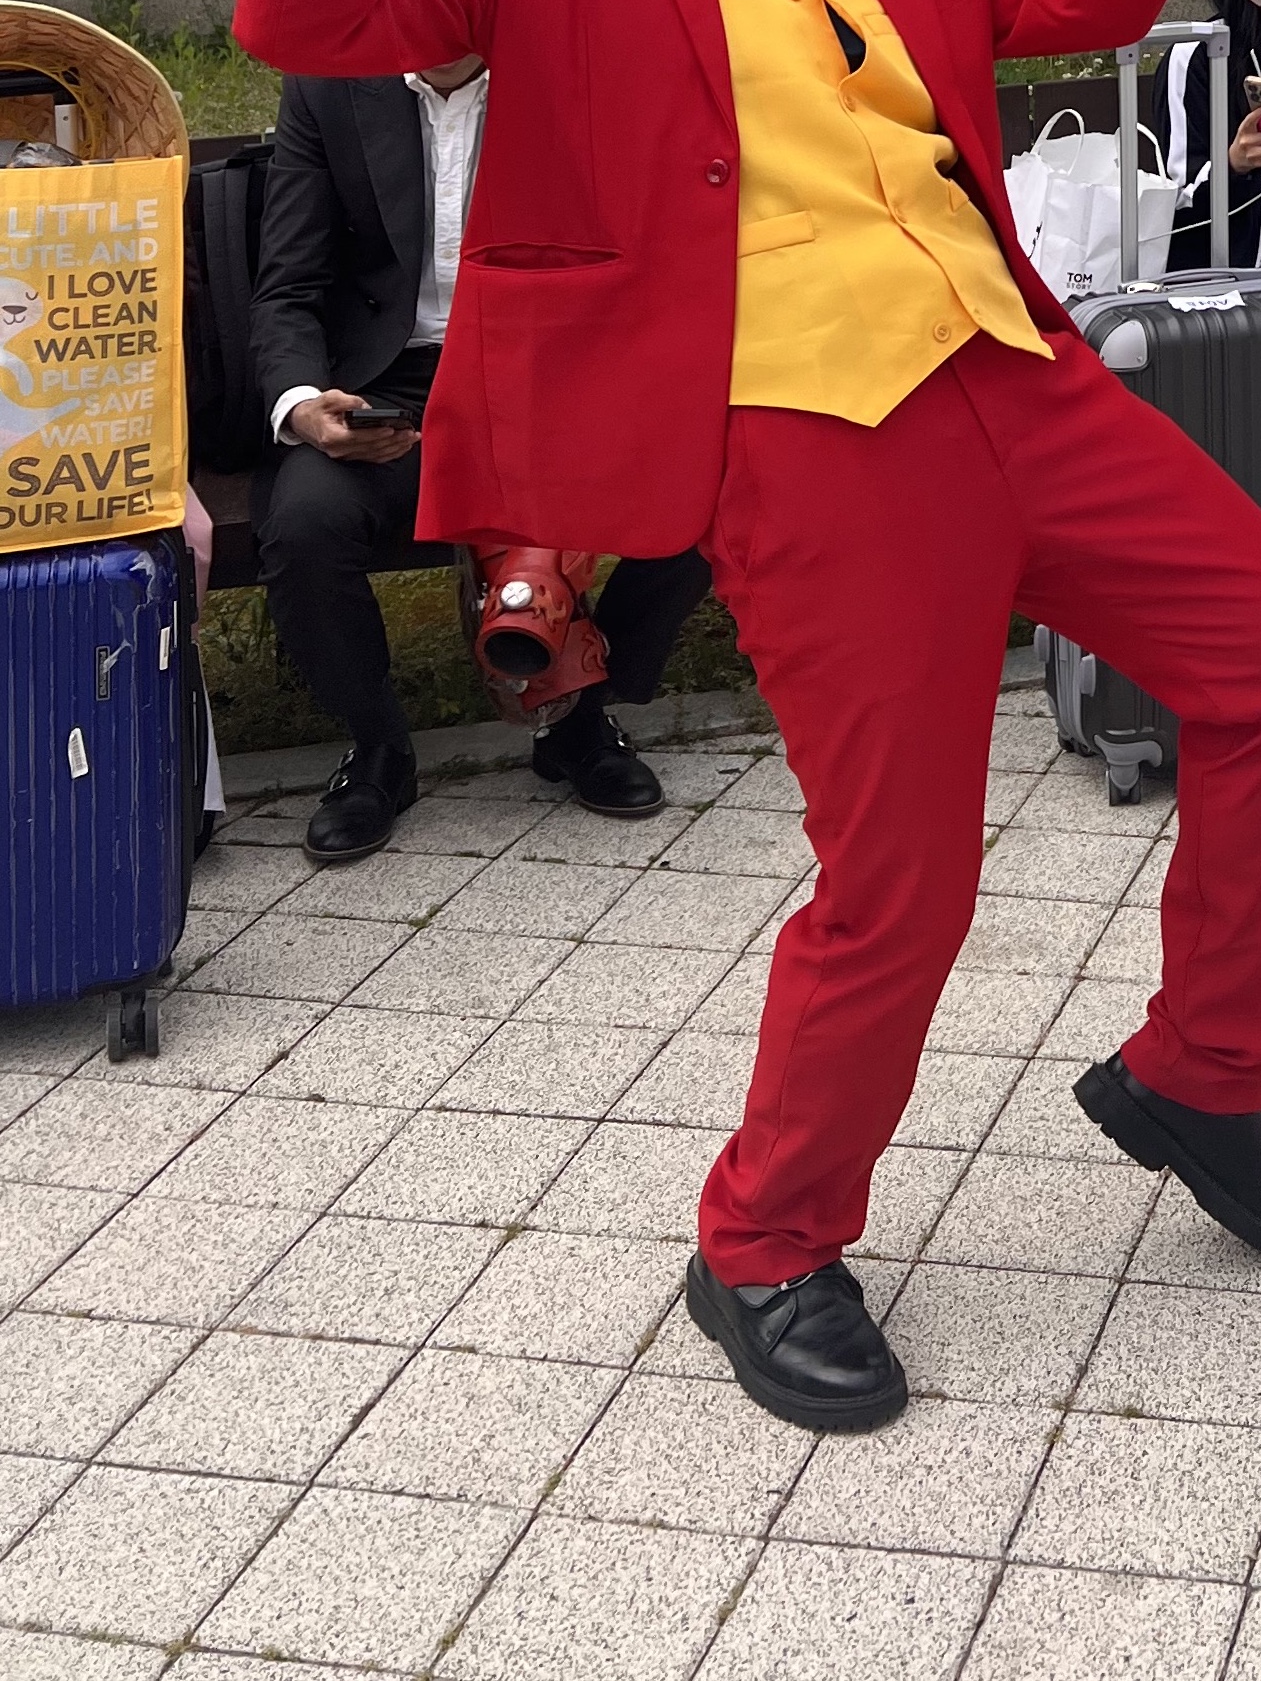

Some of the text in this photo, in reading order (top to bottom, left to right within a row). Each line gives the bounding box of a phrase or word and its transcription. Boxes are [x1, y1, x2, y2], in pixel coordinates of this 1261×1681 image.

[8, 199, 158, 238] LITTLE
[89, 237, 158, 266] AND
[47, 267, 157, 300] I LOVE
[1067, 272, 1093, 283] TOM
[48, 300, 157, 331] CLEAN
[34, 330, 162, 363] WATER.
[43, 359, 157, 392] PLEASE
[85, 388, 154, 416] SAVE
[40, 414, 153, 448] WATER!
[7, 443, 154, 497] SAVE
[76, 489, 154, 522] LIFE!
